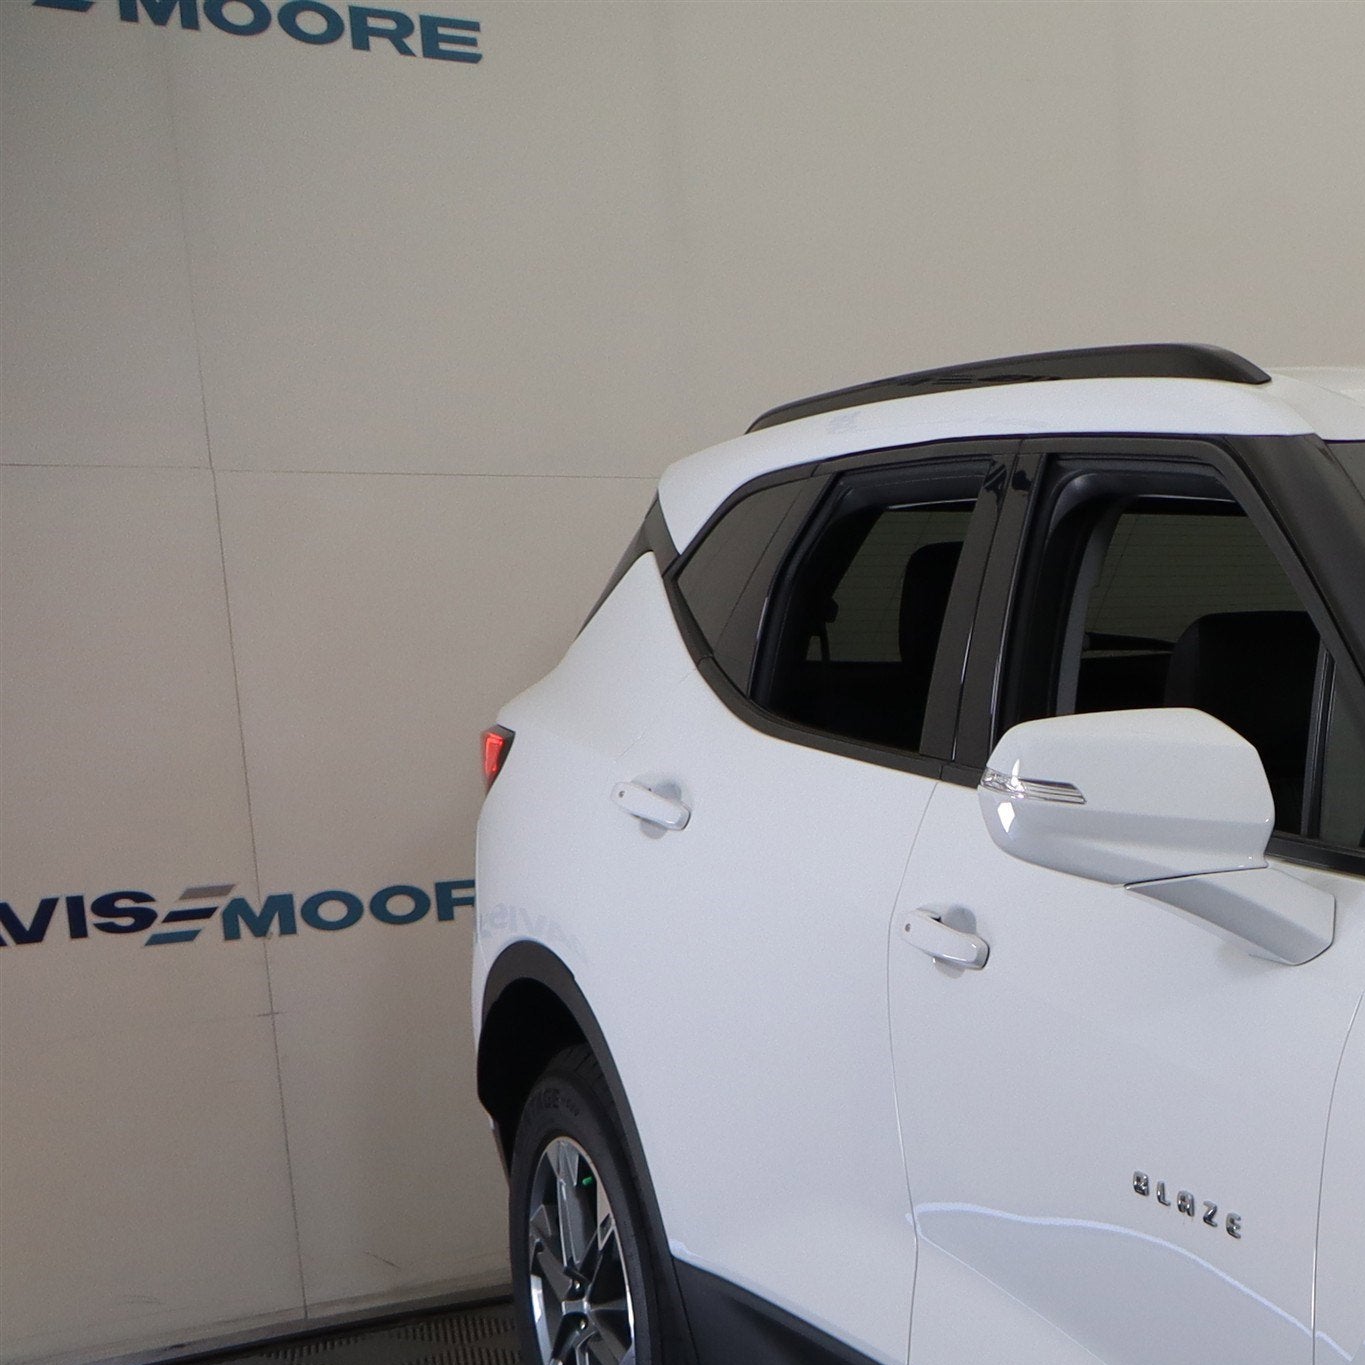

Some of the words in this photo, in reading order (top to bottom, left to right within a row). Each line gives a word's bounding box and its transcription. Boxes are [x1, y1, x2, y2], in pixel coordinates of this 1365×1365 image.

[117, 0, 483, 63] MOORE
[0, 890, 158, 946] VIS
[220, 879, 476, 942] MOOR
[1132, 1171, 1242, 1240] BLAZE
